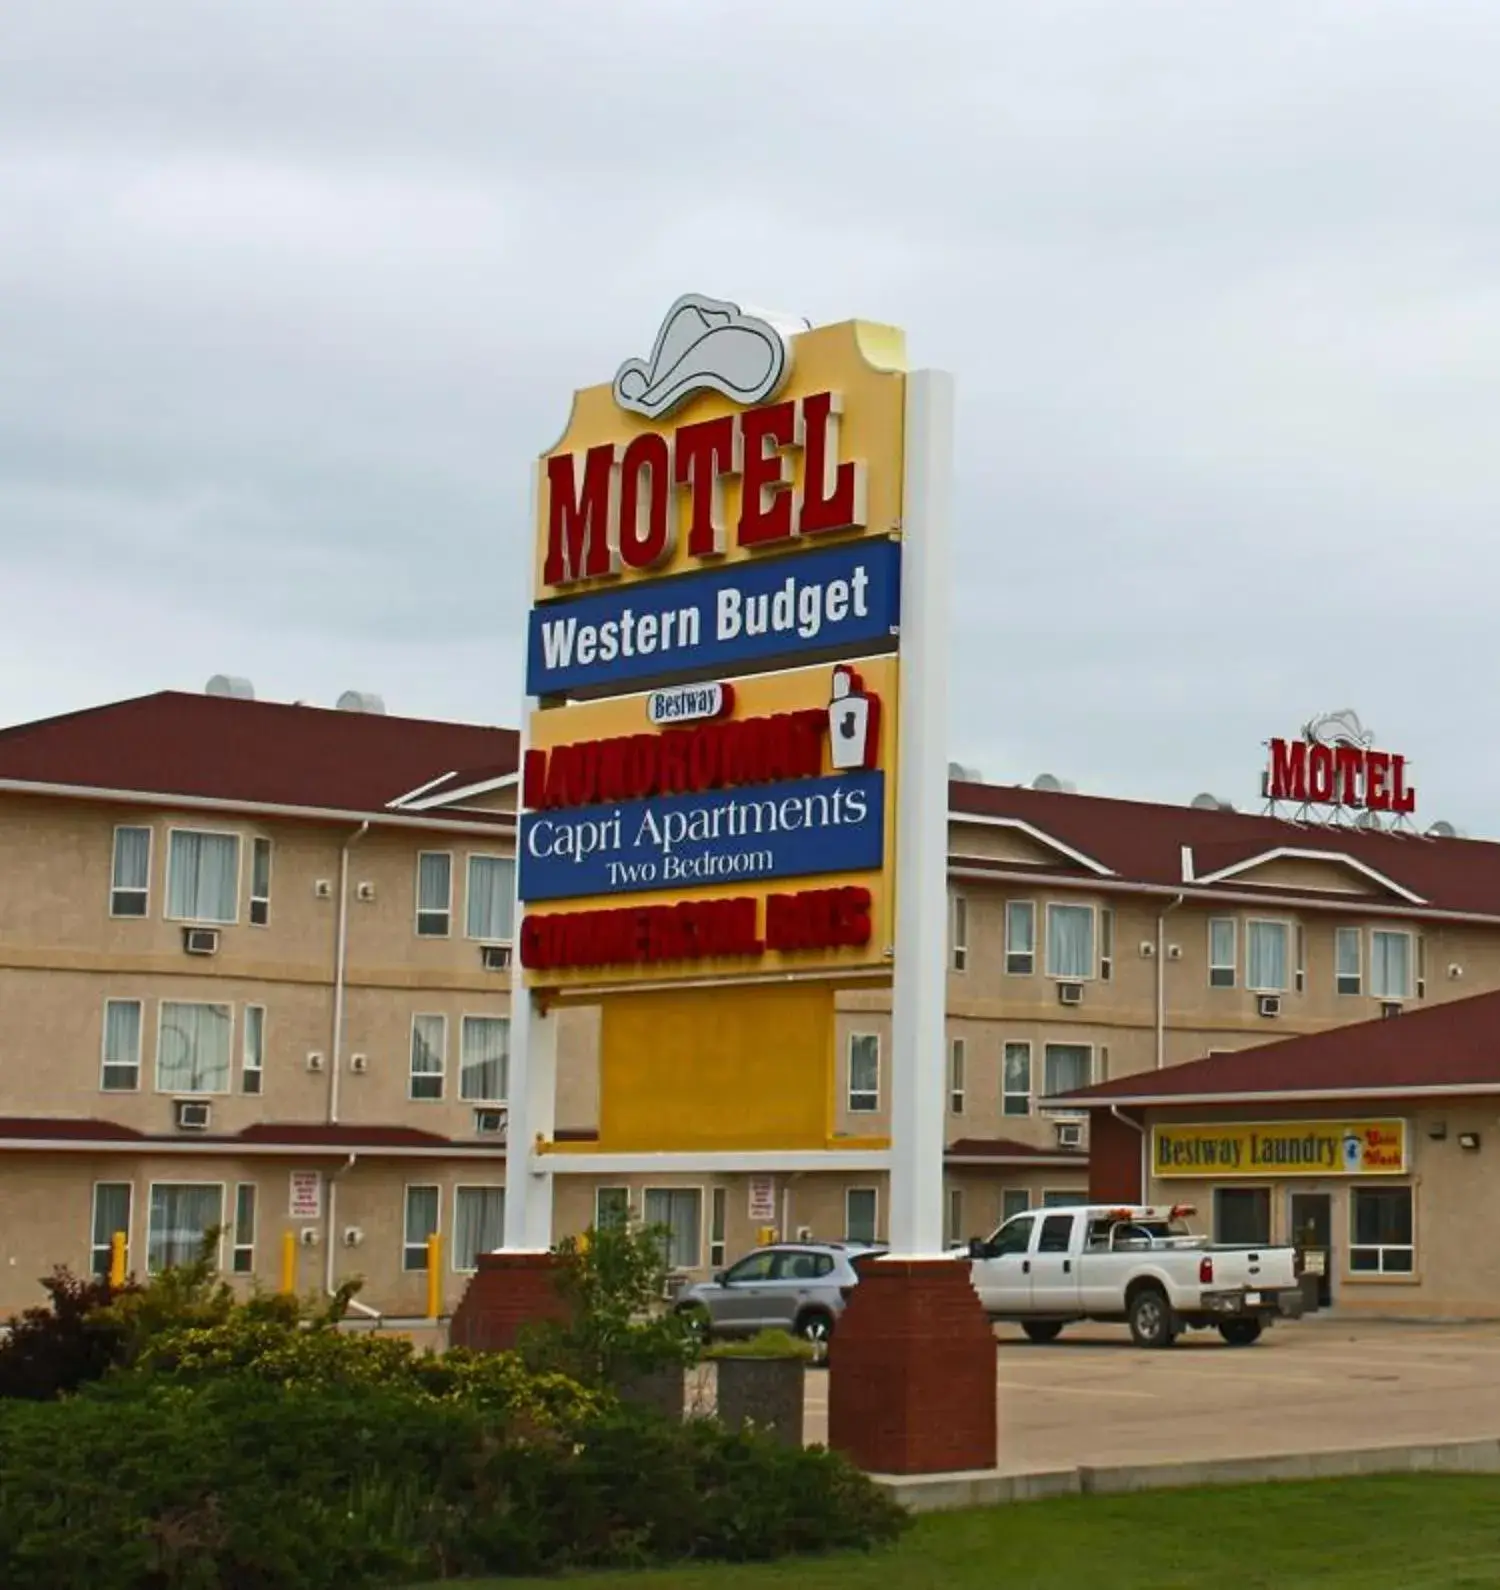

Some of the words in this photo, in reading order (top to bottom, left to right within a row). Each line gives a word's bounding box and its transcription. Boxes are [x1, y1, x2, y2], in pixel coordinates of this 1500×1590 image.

[543, 391, 856, 587] MOTEL
[541, 606, 700, 670] Western
[716, 566, 869, 641] Budget
[653, 685, 717, 720] Bestway
[1270, 737, 1415, 813] MOTEL
[528, 810, 622, 864] Capri
[633, 788, 867, 853] Apartments
[605, 861, 656, 886] Two
[663, 849, 773, 881] Bedroom
[1159, 1135, 1243, 1168] Bestway
[1250, 1132, 1338, 1167] Laundry
